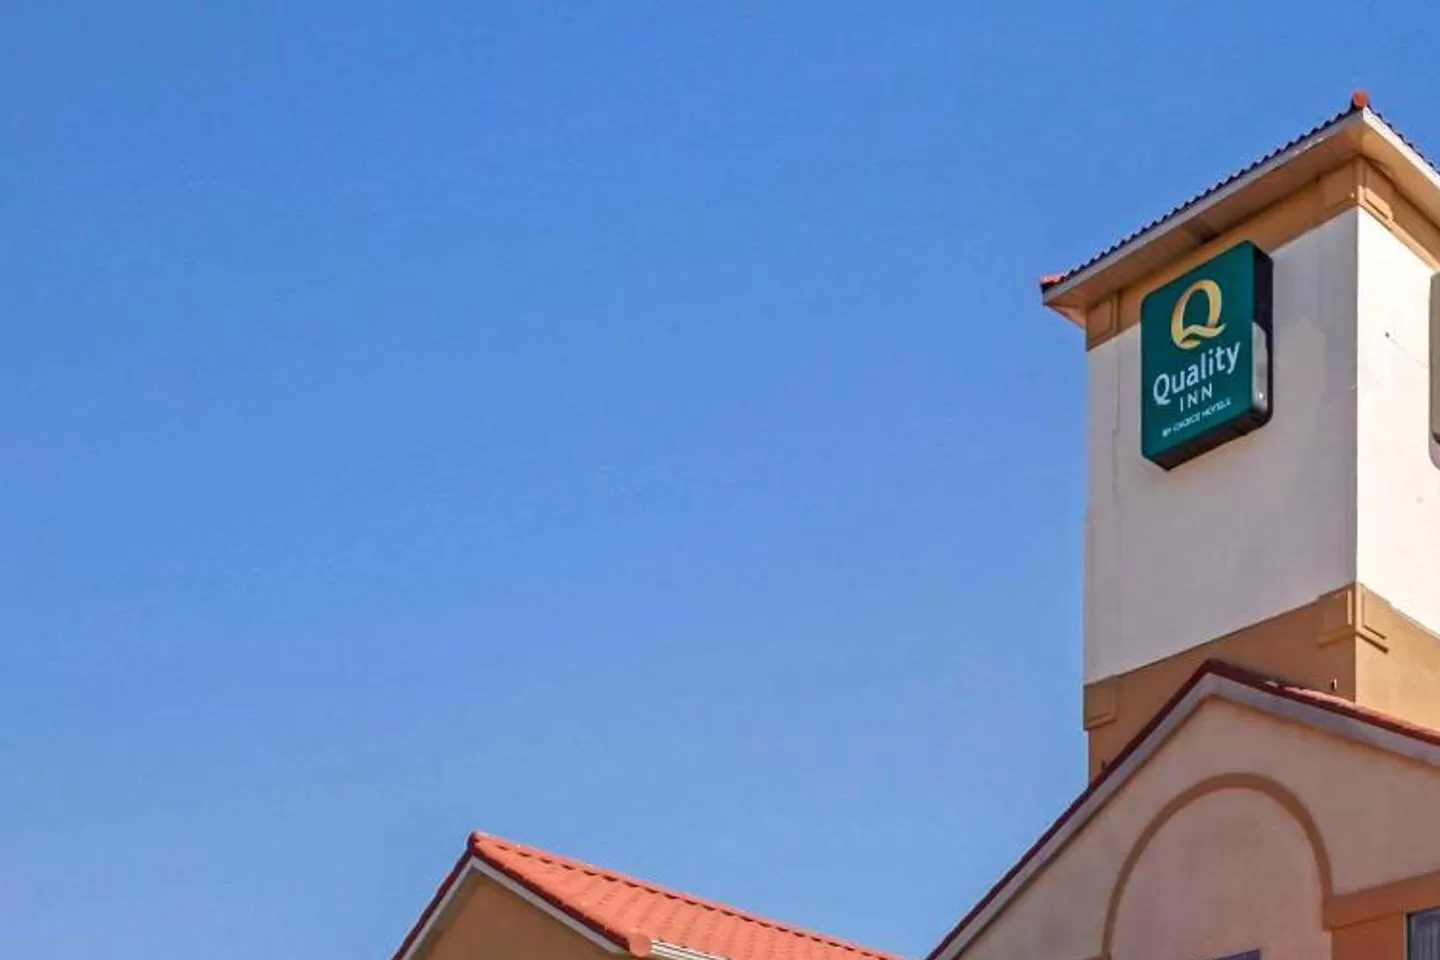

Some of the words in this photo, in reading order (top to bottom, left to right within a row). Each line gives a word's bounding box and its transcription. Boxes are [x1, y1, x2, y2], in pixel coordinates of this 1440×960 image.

[1171, 280, 1227, 349] Q
[1153, 341, 1241, 406] Quality
[1179, 382, 1213, 412] INN
